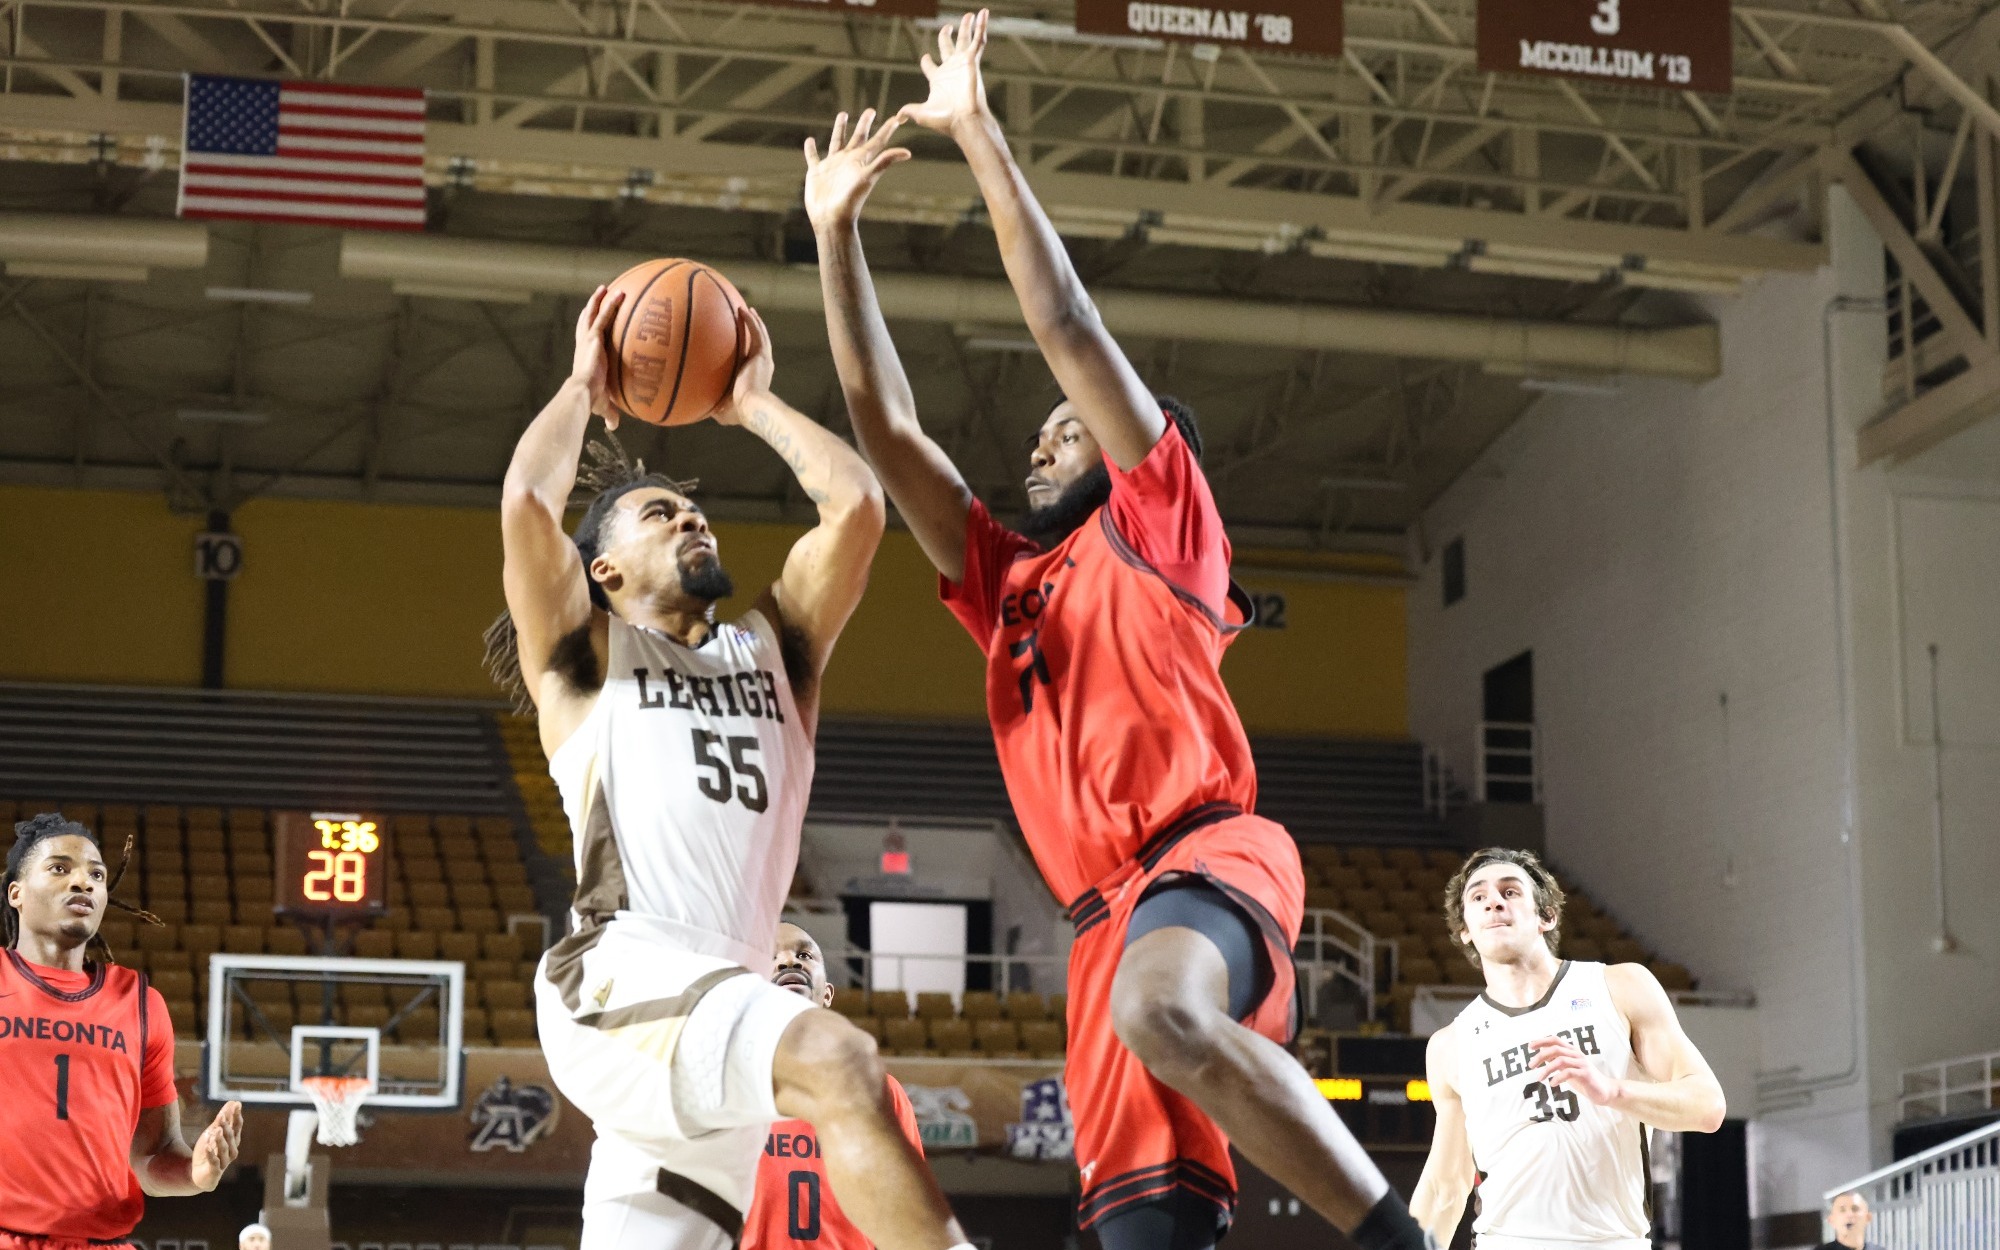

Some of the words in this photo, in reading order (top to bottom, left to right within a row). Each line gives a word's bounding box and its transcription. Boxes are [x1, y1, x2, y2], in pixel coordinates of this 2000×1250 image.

[1127, 2, 1248, 41] QUEENAN
[1518, 38, 1654, 80] MCCOLLUM
[636, 297, 673, 347] THE
[199, 538, 243, 577] 10
[633, 667, 785, 724] LEHIGH
[690, 727, 769, 814] 55
[303, 850, 367, 902] 28
[0, 1016, 127, 1054] ONEONTA
[1482, 1024, 1601, 1087] LEHH
[54, 1053, 70, 1120] 1
[1522, 1076, 1581, 1122] 35
[788, 1170, 820, 1241] 0
